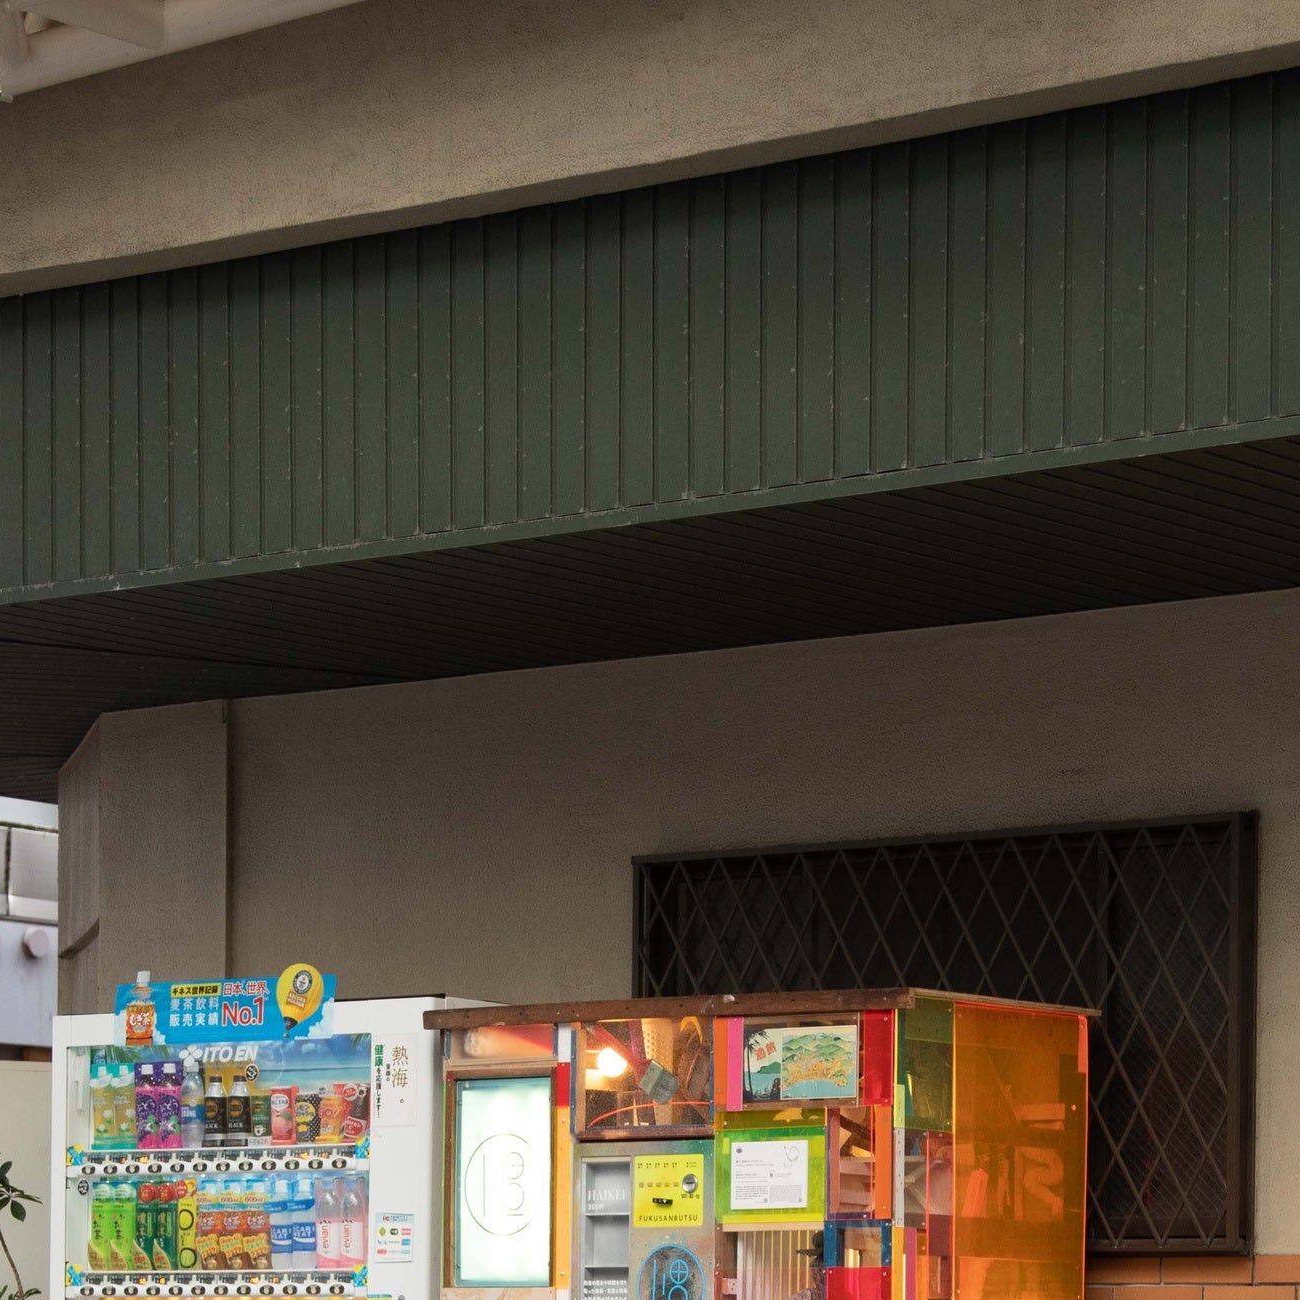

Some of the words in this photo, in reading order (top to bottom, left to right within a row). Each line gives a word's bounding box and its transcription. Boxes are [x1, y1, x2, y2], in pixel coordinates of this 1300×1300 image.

[170, 997, 219, 1012] 麦茶飲料
[169, 1012, 219, 1028] 販売実績
[202, 1046, 234, 1063] ITO
[234, 1045, 259, 1062] EN
[392, 1045, 409, 1088] 熱海
[638, 1214, 698, 1222] FUKUSANBUTSU
